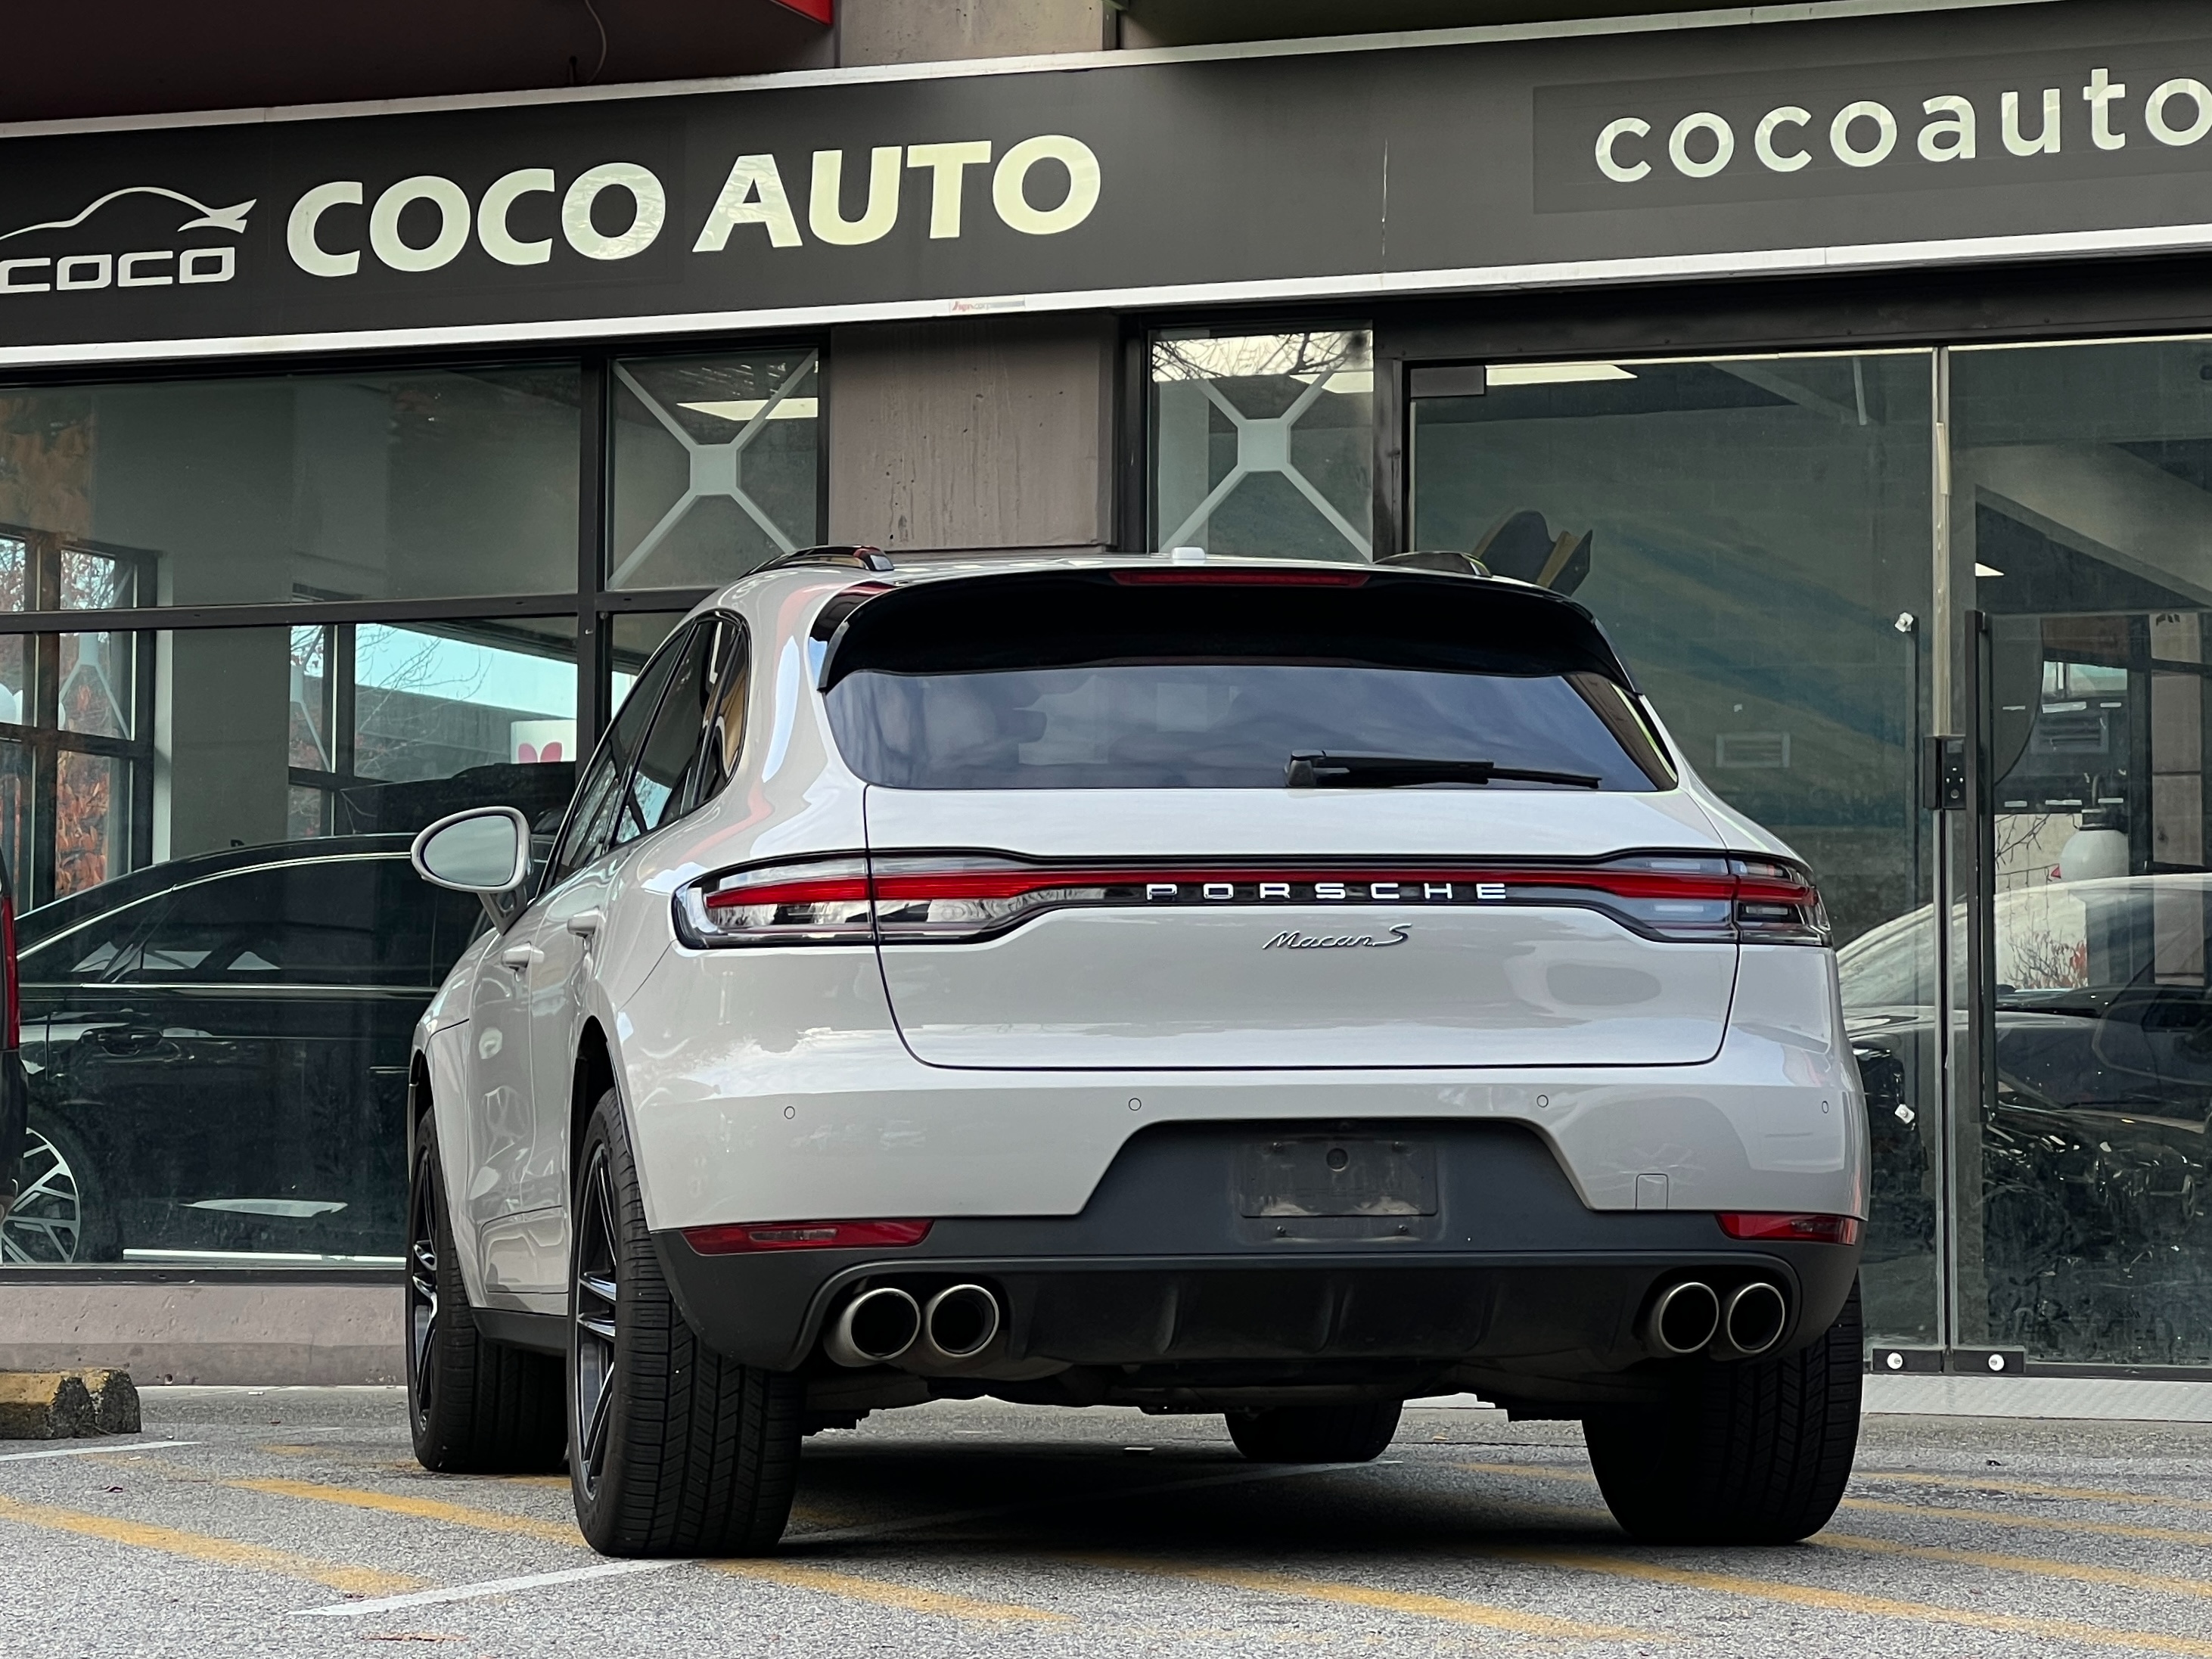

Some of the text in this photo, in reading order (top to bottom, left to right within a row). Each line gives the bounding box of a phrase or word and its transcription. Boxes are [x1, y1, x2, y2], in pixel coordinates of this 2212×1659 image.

[1595, 68, 2212, 182] cocoauto
[287, 134, 1101, 278] COCO AUTO
[0, 247, 235, 294] COCO
[1146, 882, 1507, 900] PORSCHE
[1262, 923, 1412, 949] Macan S
